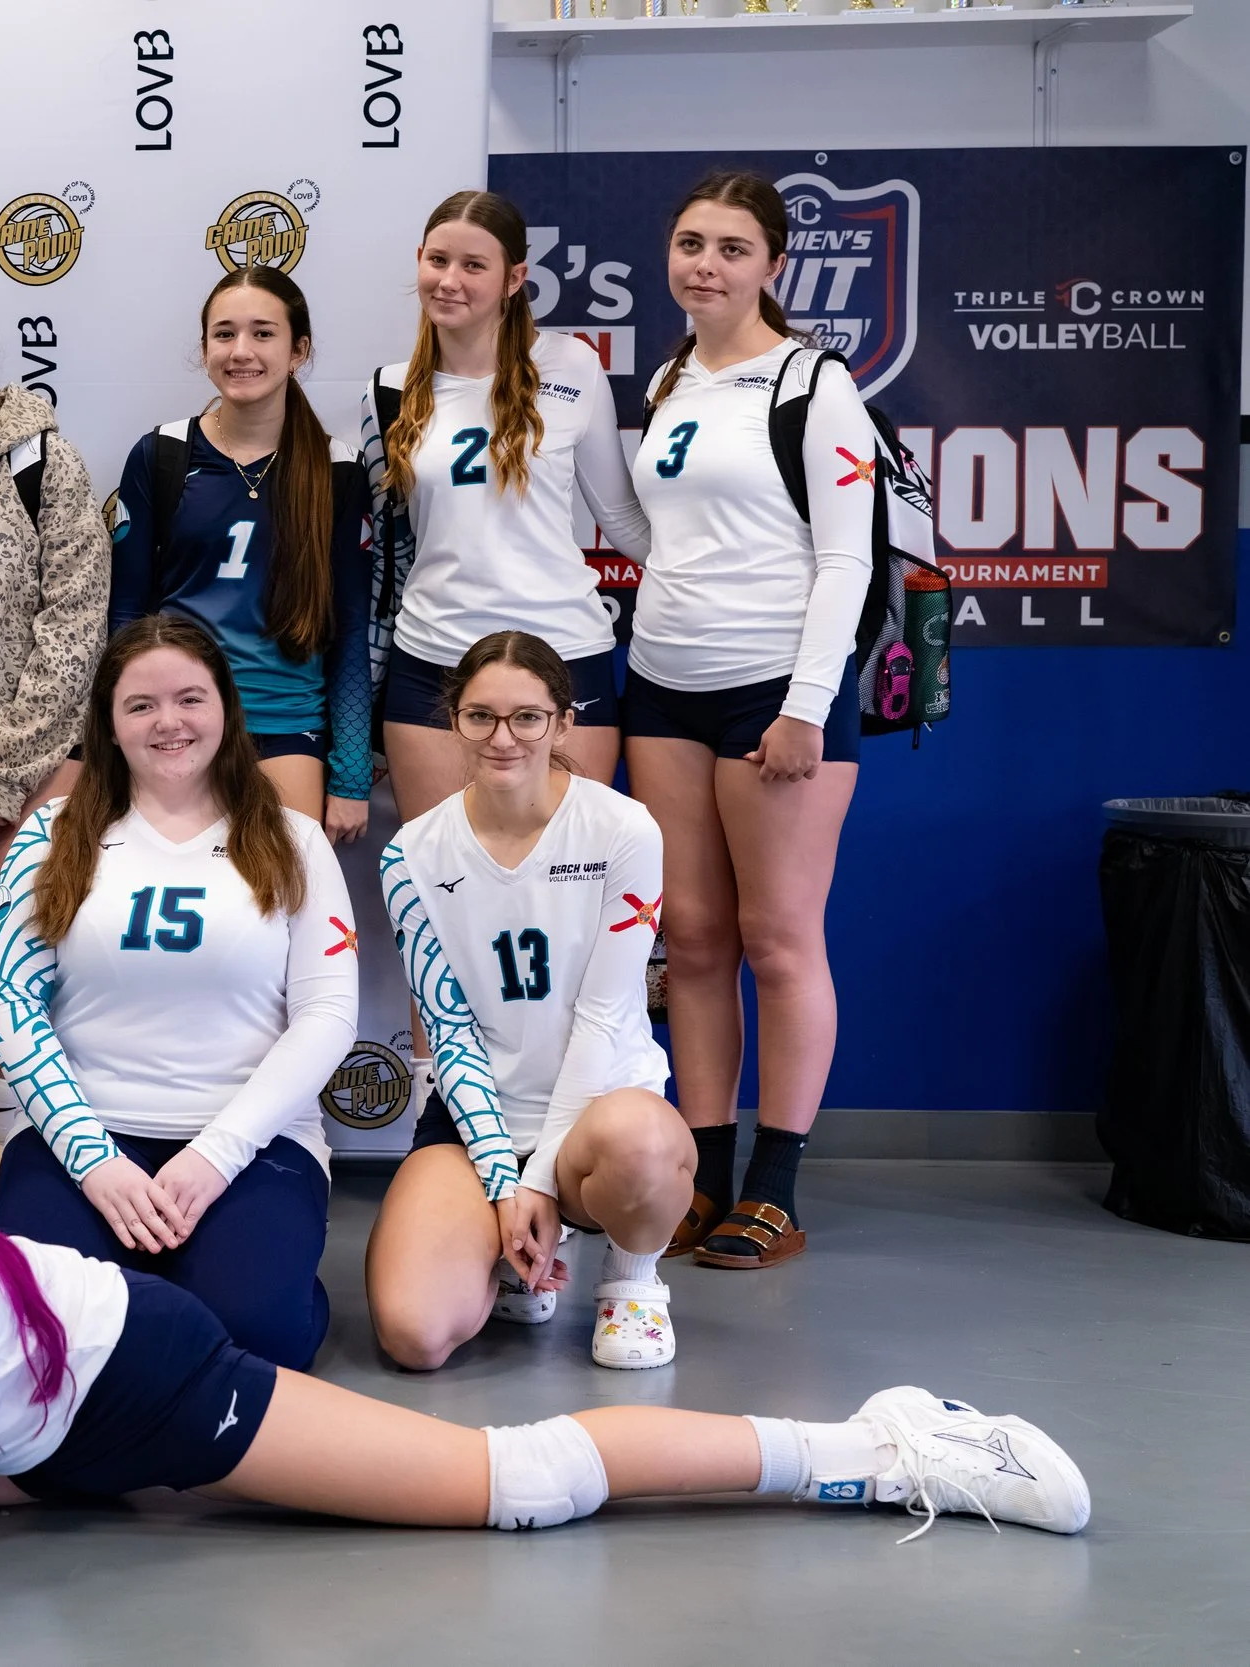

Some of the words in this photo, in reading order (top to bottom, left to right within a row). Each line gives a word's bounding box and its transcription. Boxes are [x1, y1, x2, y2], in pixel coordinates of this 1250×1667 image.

[134, 29, 174, 150] LOVB
[362, 23, 403, 148] LOVB
[24, 226, 85, 271] POINT
[205, 213, 276, 250] GAME
[246, 225, 309, 268] POINT
[954, 291, 1046, 306] TRIPLE
[1111, 290, 1204, 304] CROWN
[968, 322, 1186, 350] VOLLEYBALL
[554, 384, 581, 398] WAVE
[559, 394, 576, 403] CLUB
[450, 426, 490, 487] 2
[656, 420, 699, 479] 3
[216, 520, 256, 579] 1
[940, 564, 1101, 582] OURNAMENT
[549, 864, 580, 875] BEACH
[549, 874, 590, 882] VOLLEYBALL
[120, 886, 206, 953] 15
[491, 927, 551, 1002] 13
[326, 1063, 379, 1092] AME
[352, 1075, 414, 1115] POINT
